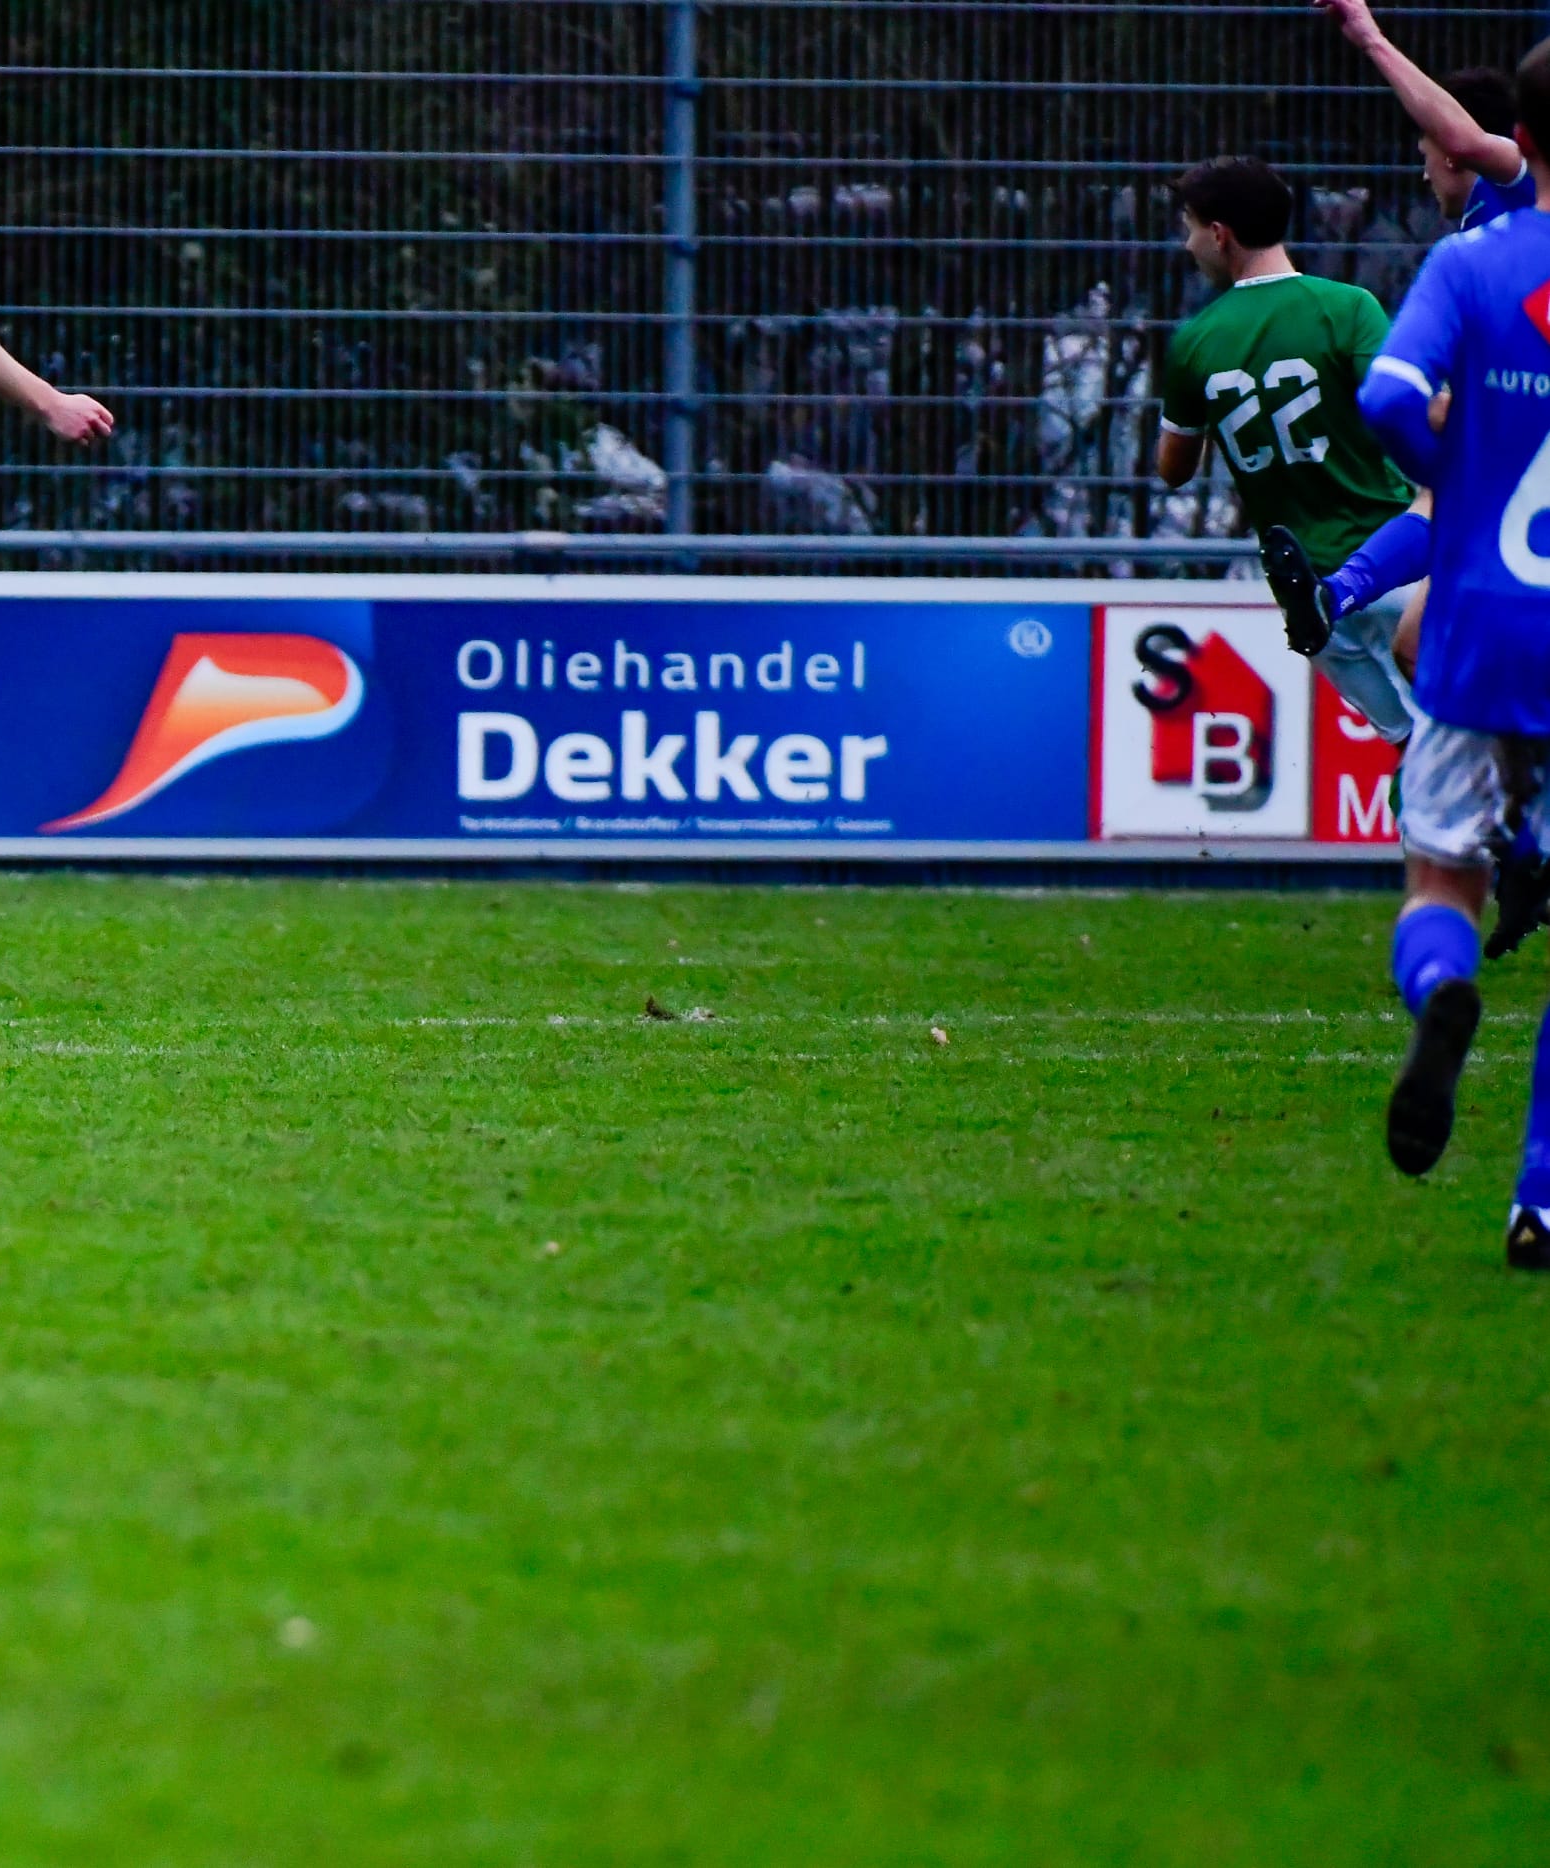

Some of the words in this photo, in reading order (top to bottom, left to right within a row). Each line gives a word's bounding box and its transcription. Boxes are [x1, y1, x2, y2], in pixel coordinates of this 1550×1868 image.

[1204, 357, 1330, 473] 22
[456, 638, 866, 691] Oliehandel
[457, 710, 888, 802] Dekker
